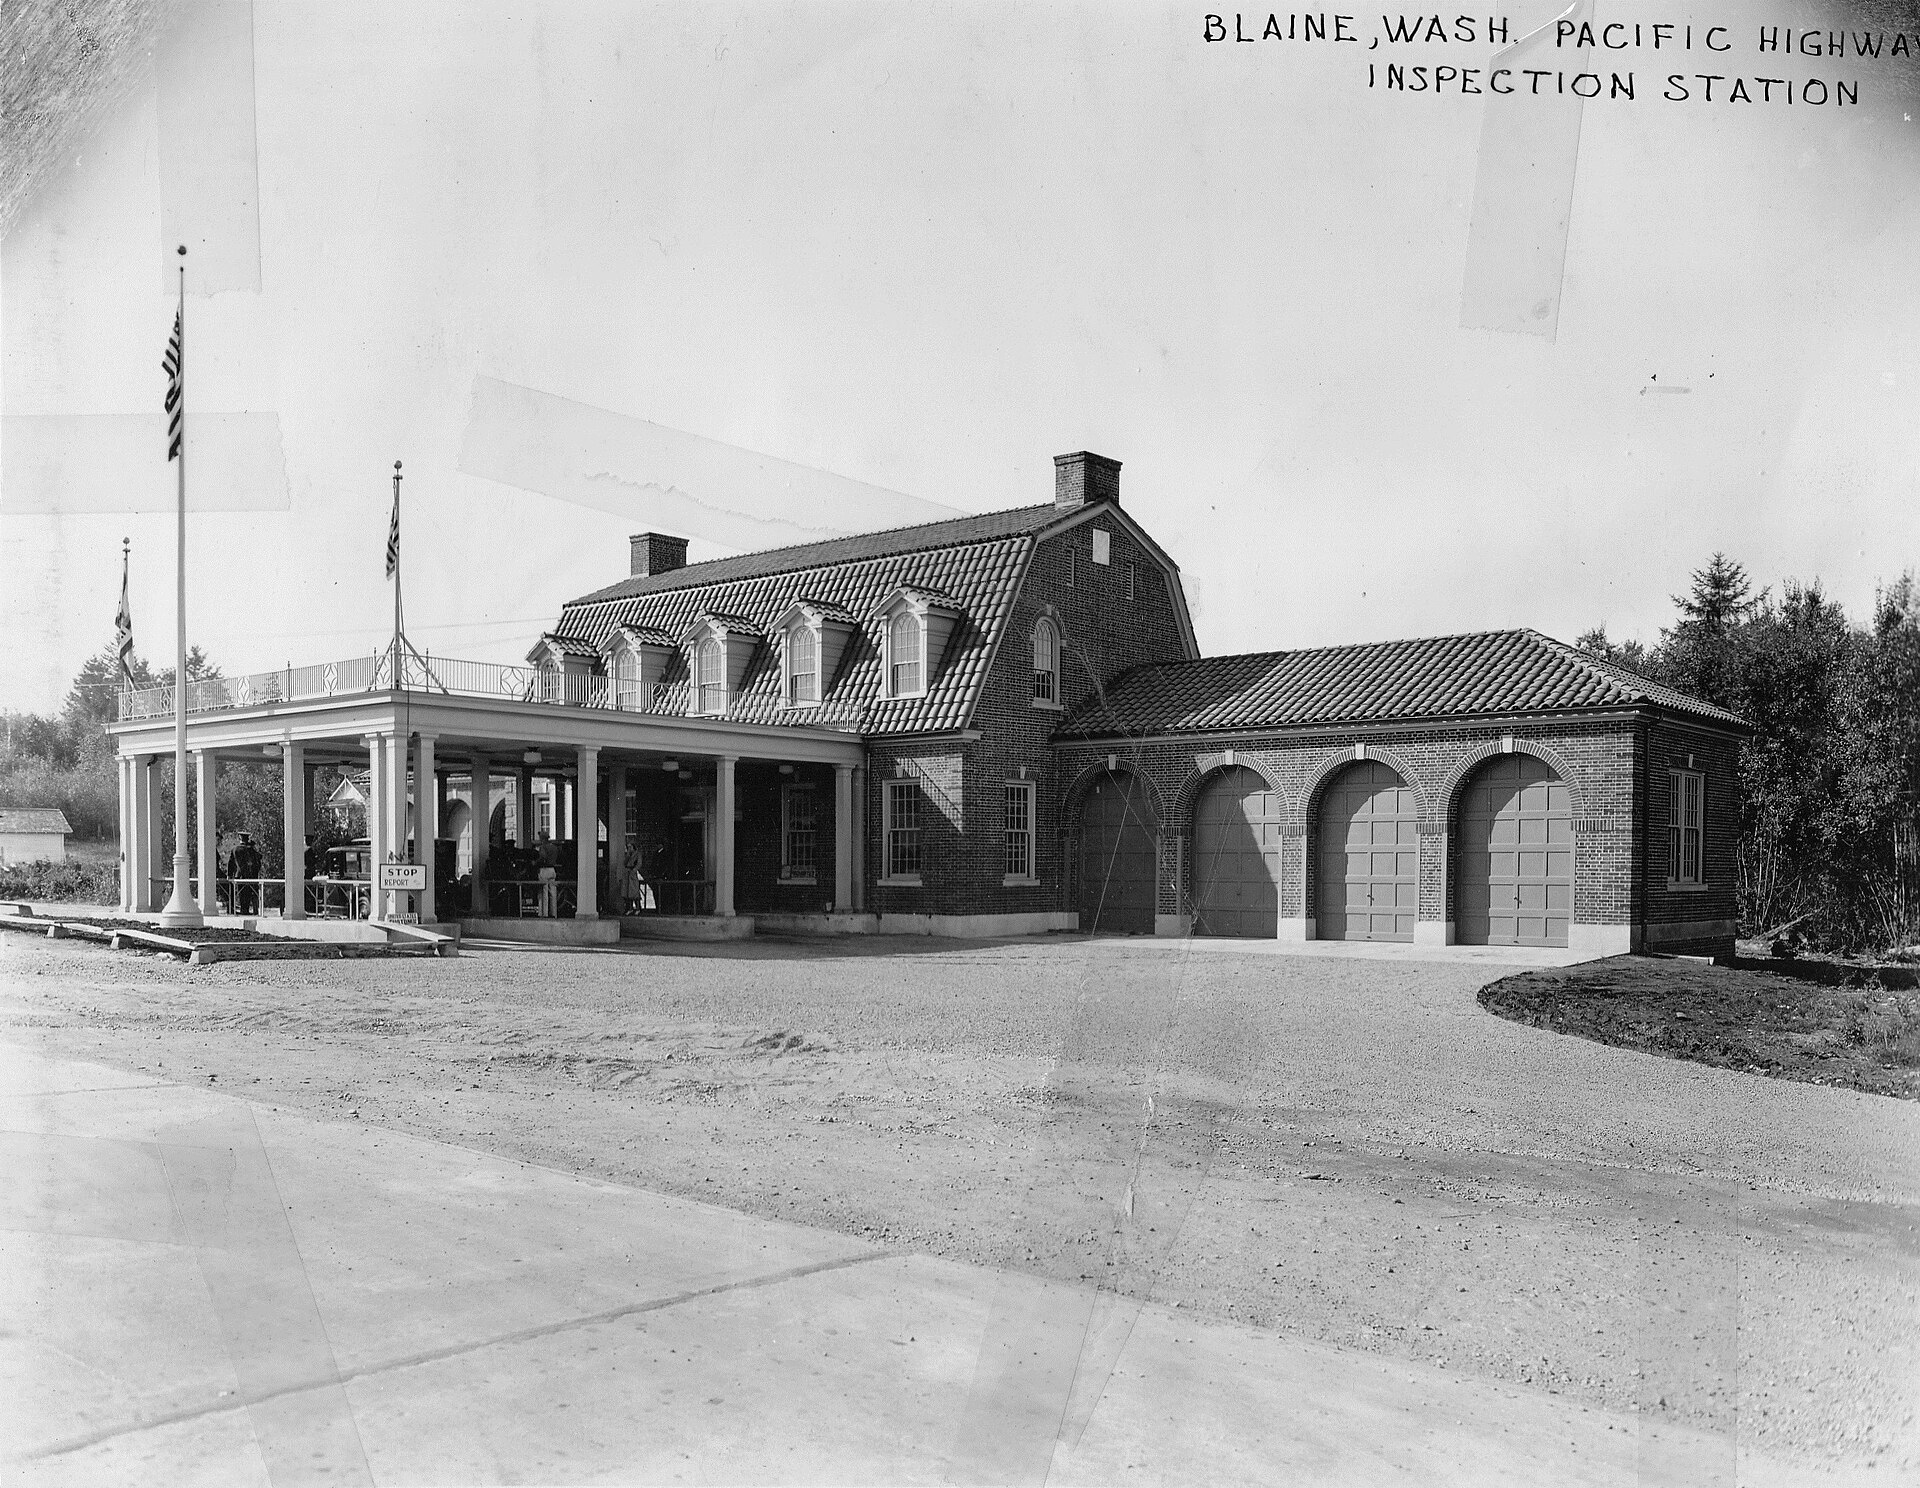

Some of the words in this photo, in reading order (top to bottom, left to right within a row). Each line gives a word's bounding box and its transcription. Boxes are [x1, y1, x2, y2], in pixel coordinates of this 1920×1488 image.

[1556, 19, 1732, 53] PACIFIC
[1368, 63, 1635, 101] INSPECTION
[1663, 74, 1858, 106] STATION
[384, 879, 409, 887] REPORT
[387, 868, 418, 877] STOP
